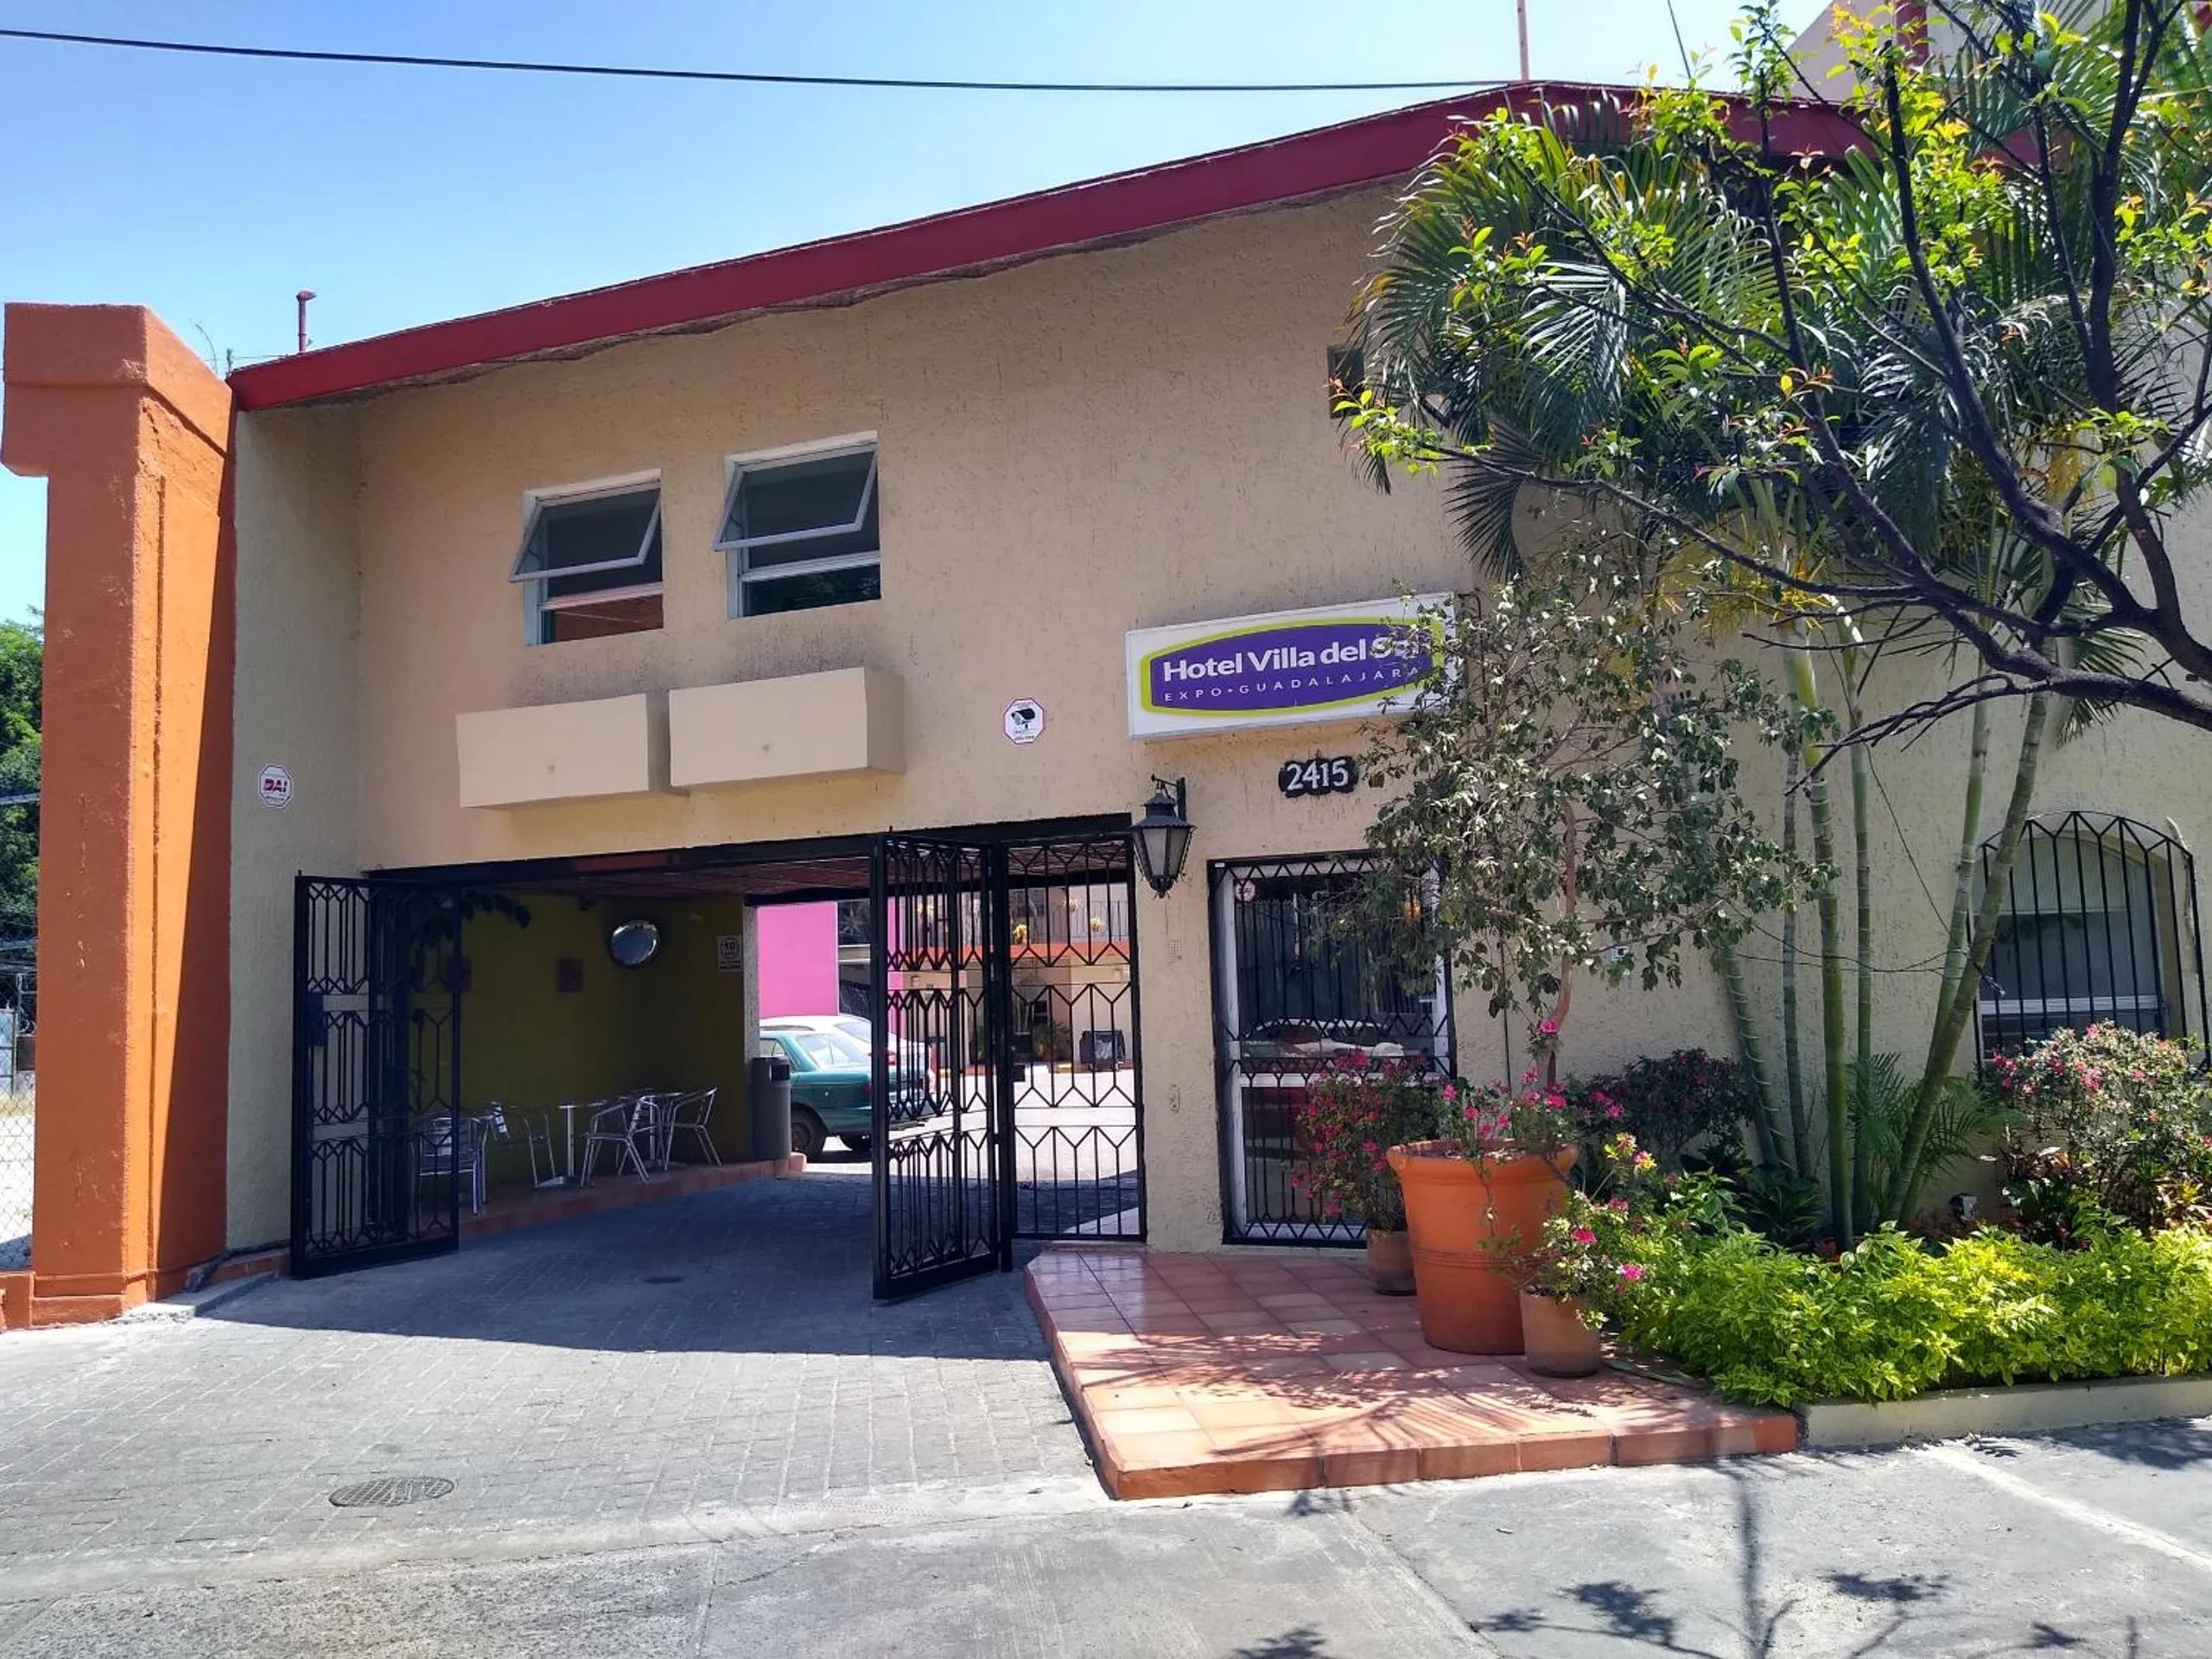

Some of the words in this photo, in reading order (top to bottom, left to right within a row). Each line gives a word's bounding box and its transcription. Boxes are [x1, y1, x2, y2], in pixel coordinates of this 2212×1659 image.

[1163, 652, 1243, 682] Hotel
[1247, 646, 1316, 672] Villa
[1320, 638, 1367, 664] del
[1286, 759, 1349, 791] 2415
